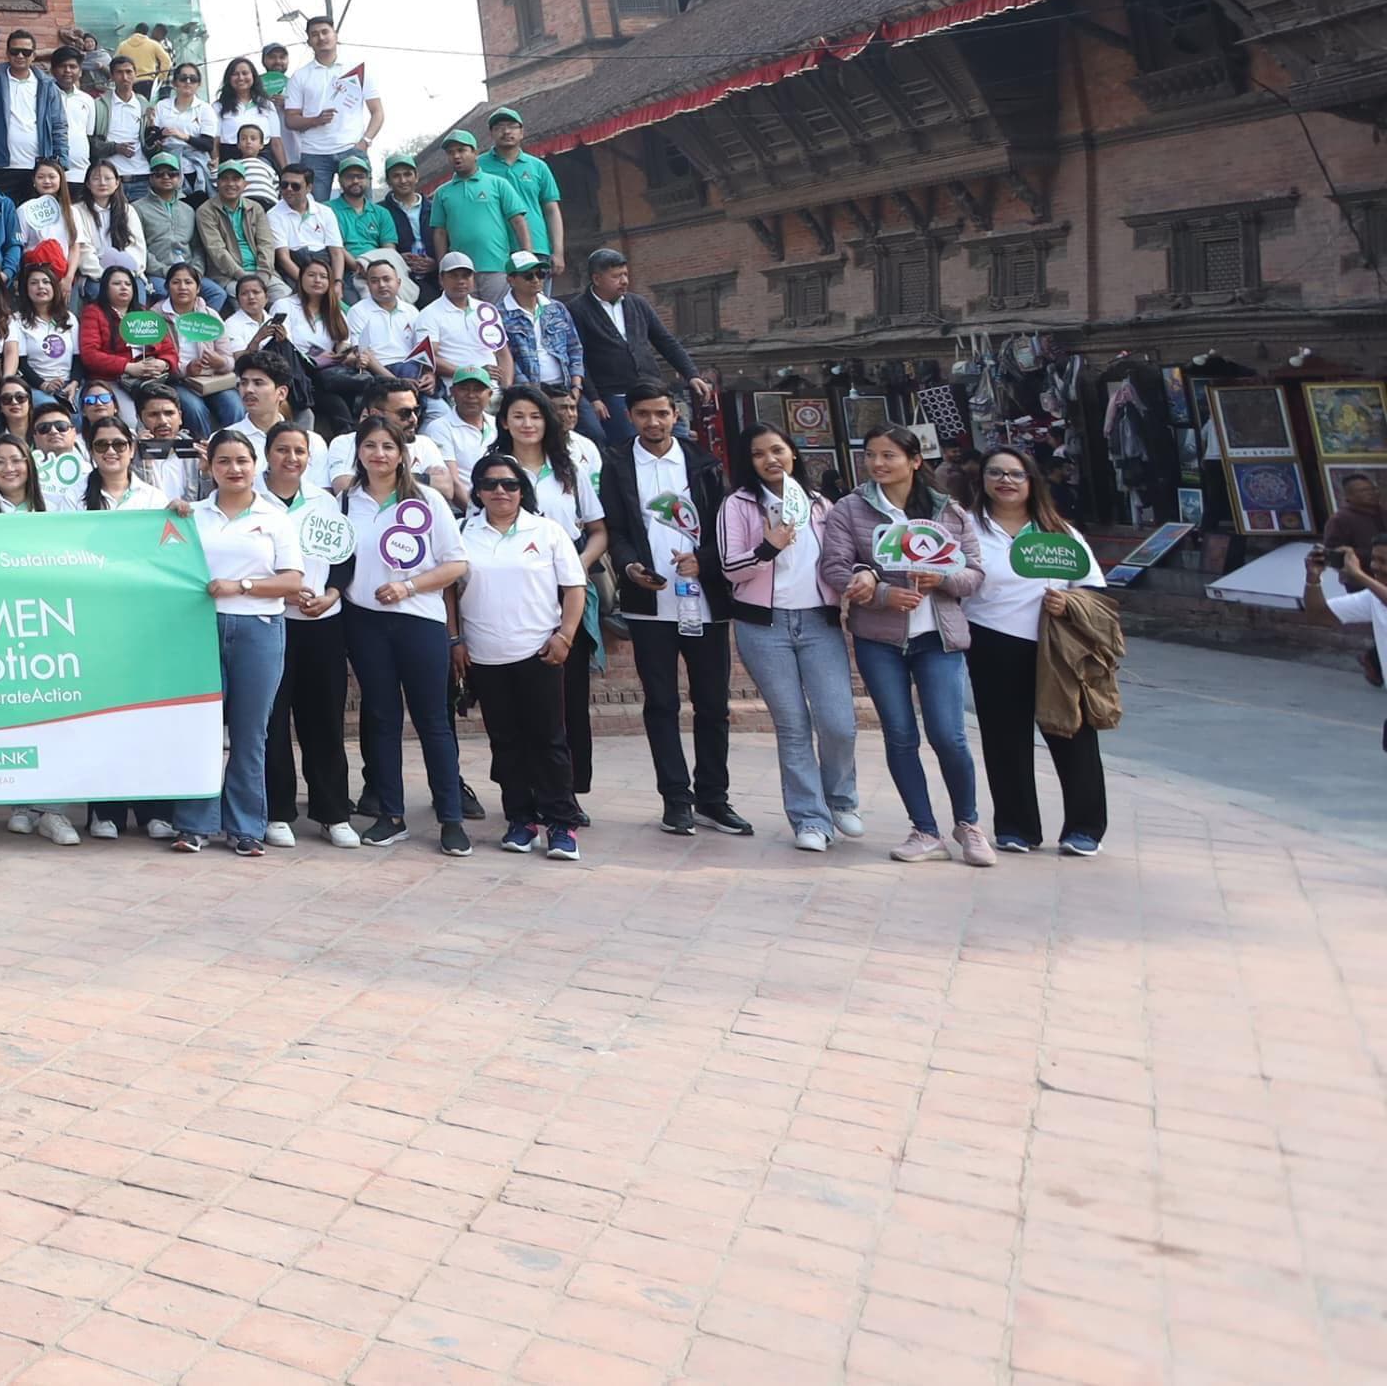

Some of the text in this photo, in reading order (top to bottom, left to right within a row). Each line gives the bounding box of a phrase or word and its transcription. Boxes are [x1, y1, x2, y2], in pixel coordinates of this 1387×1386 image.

[477, 303, 506, 349] 8
[309, 515, 345, 533] SINCE
[308, 528, 342, 549] 1984
[380, 501, 432, 569] 8
[391, 540, 414, 554] MARCH
[1020, 544, 1075, 558] WOMEN
[0, 551, 105, 569] Sustainability
[1035, 555, 1077, 567] Motion
